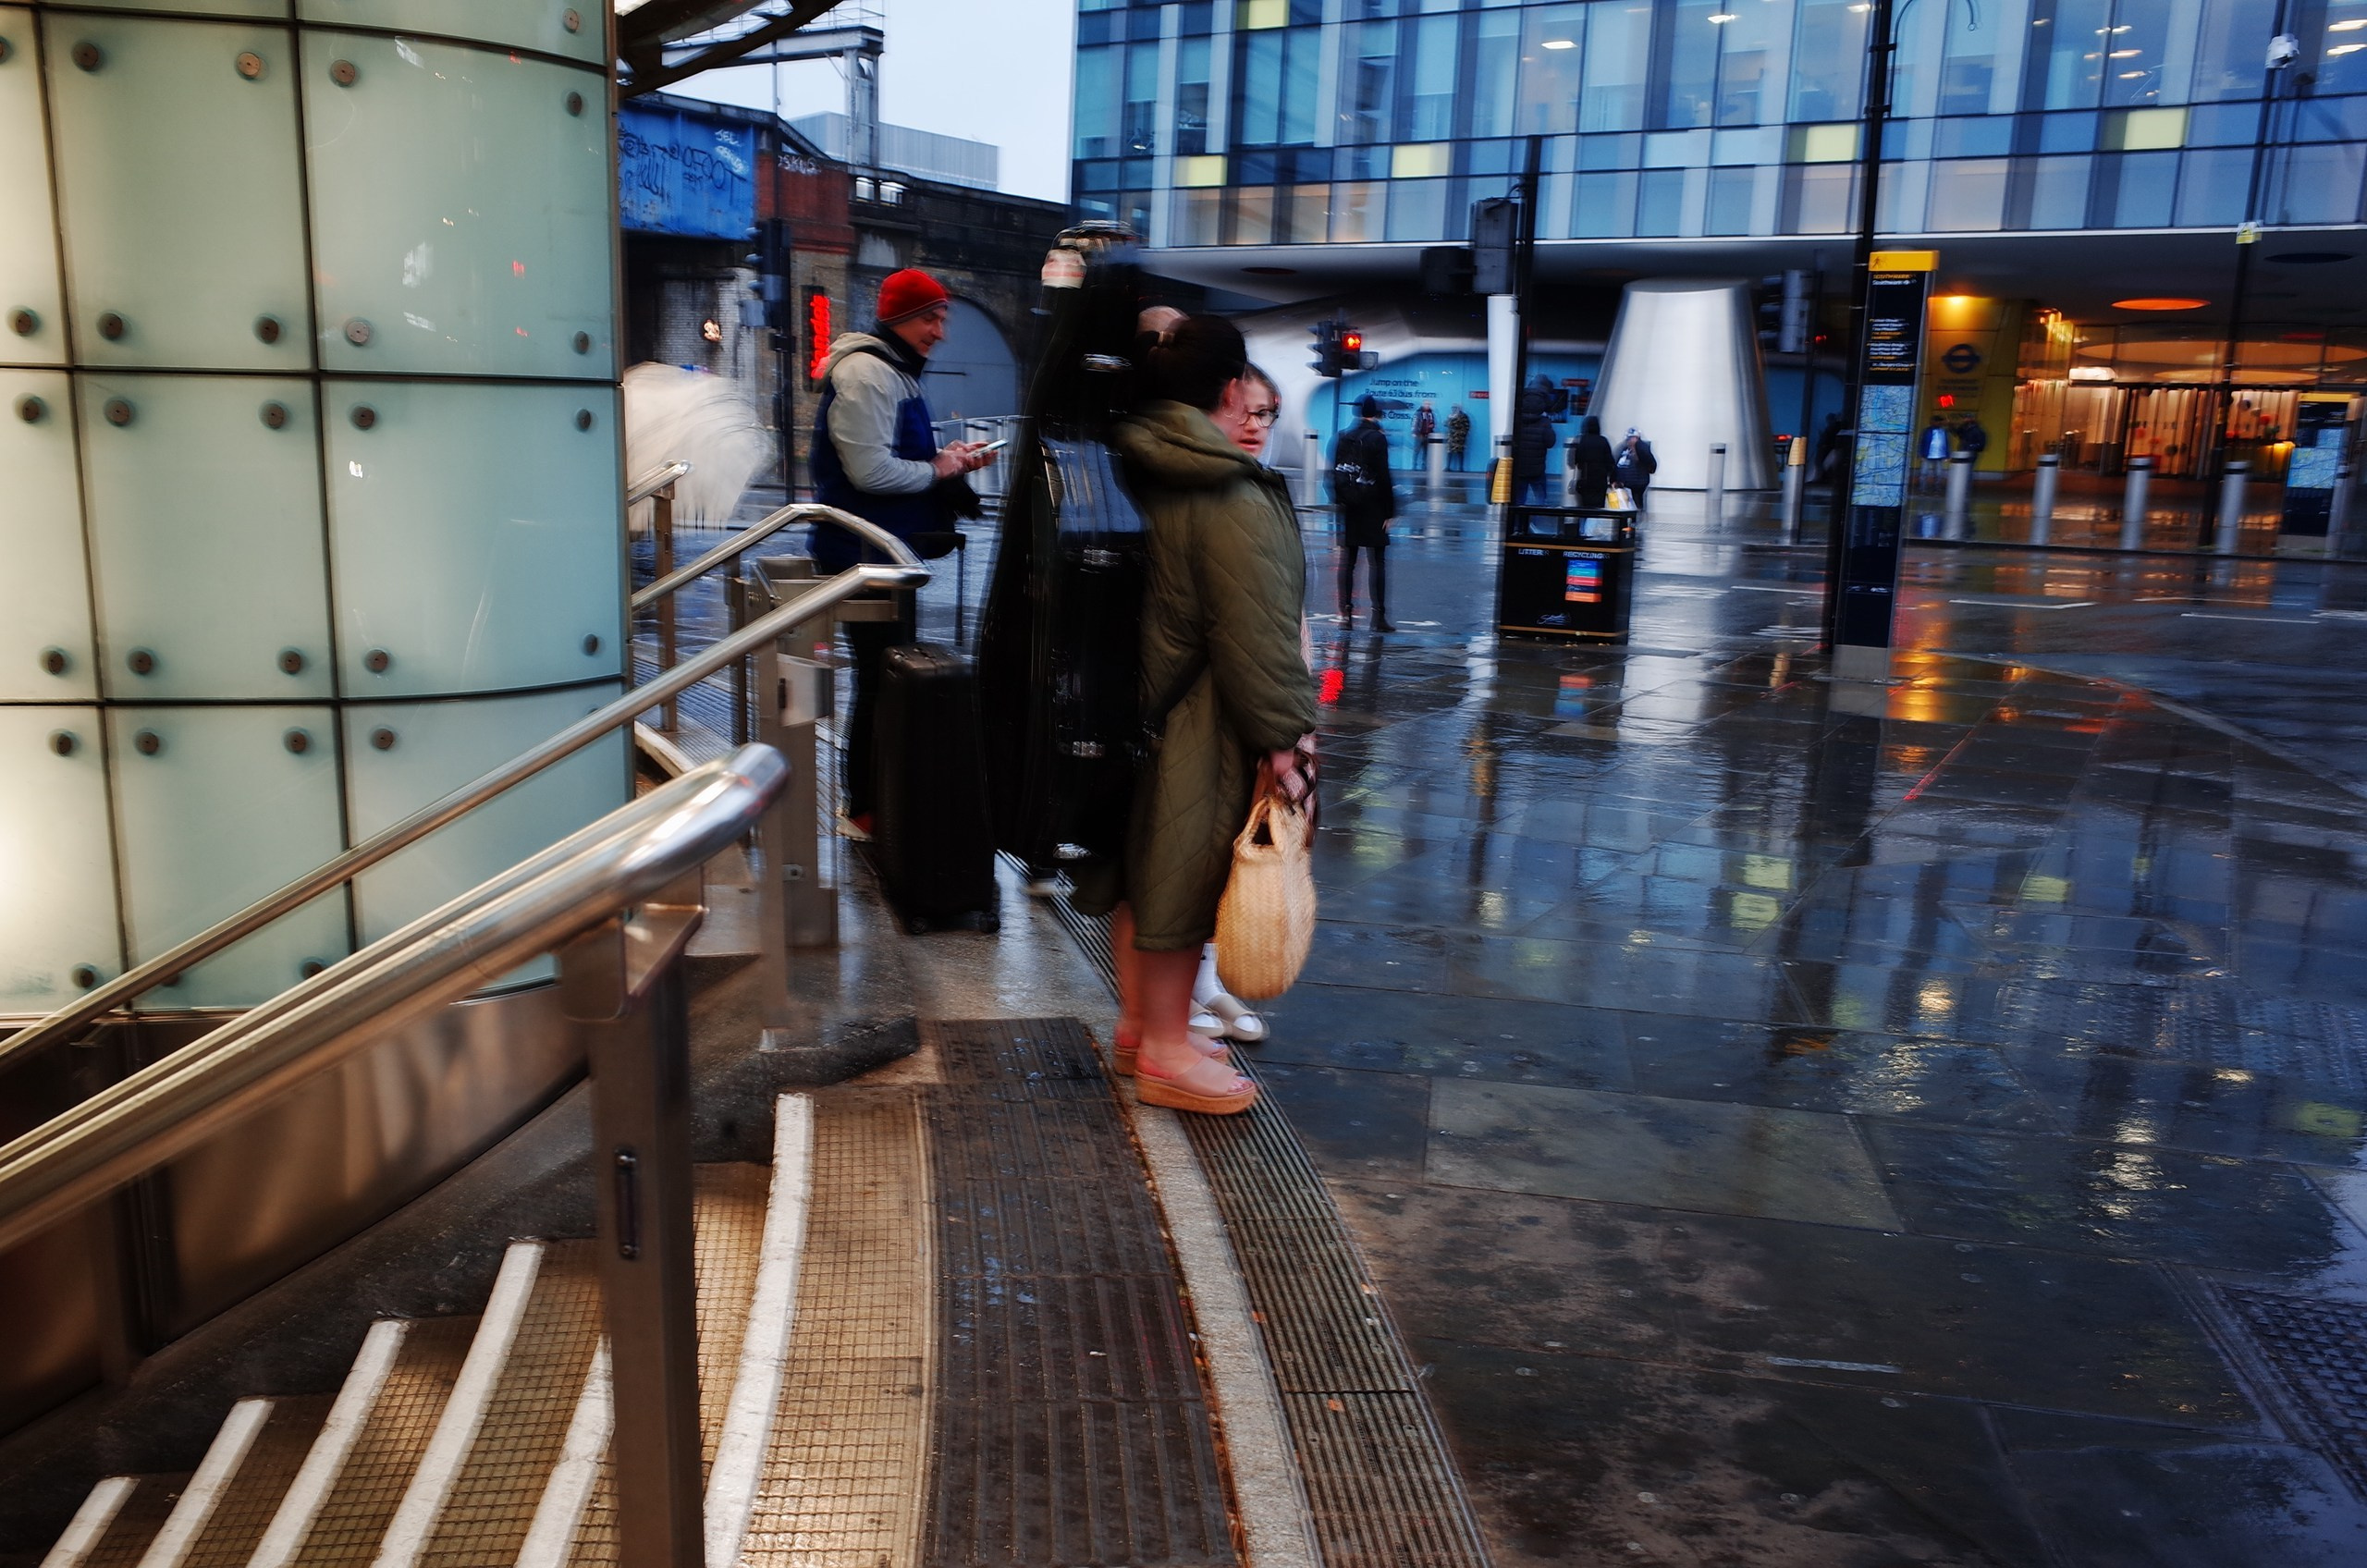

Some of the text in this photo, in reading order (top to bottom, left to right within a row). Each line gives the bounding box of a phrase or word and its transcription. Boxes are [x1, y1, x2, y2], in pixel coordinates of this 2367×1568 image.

[1369, 378, 1391, 387] Jump
[1415, 389, 1437, 398] from
[1564, 551, 1605, 559] RECYCLING
